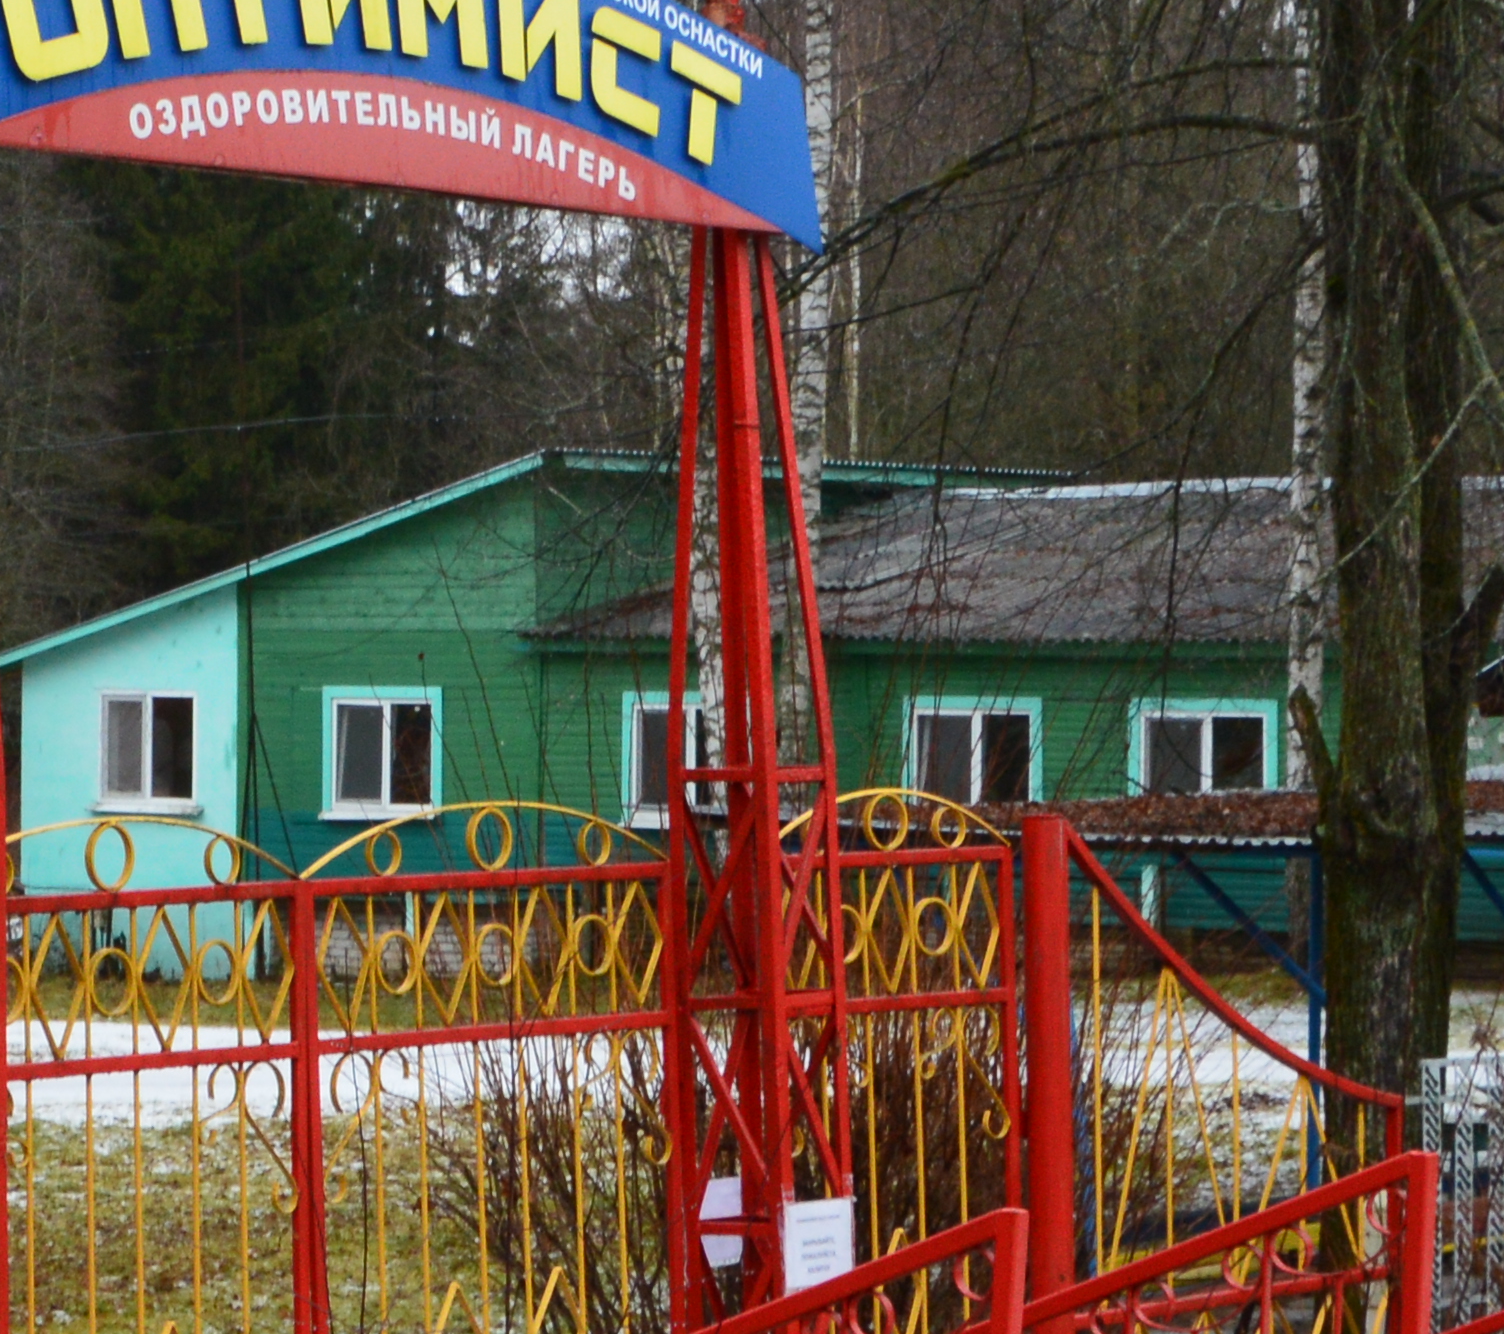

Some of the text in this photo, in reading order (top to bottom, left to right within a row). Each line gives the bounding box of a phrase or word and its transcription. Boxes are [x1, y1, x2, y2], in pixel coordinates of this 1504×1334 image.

[663, 4, 764, 80] ОСНАСТКИ
[129, 89, 636, 202] ОЗДОРОВИТЕЛЬНЫЙ ЛАГЕРЬ
